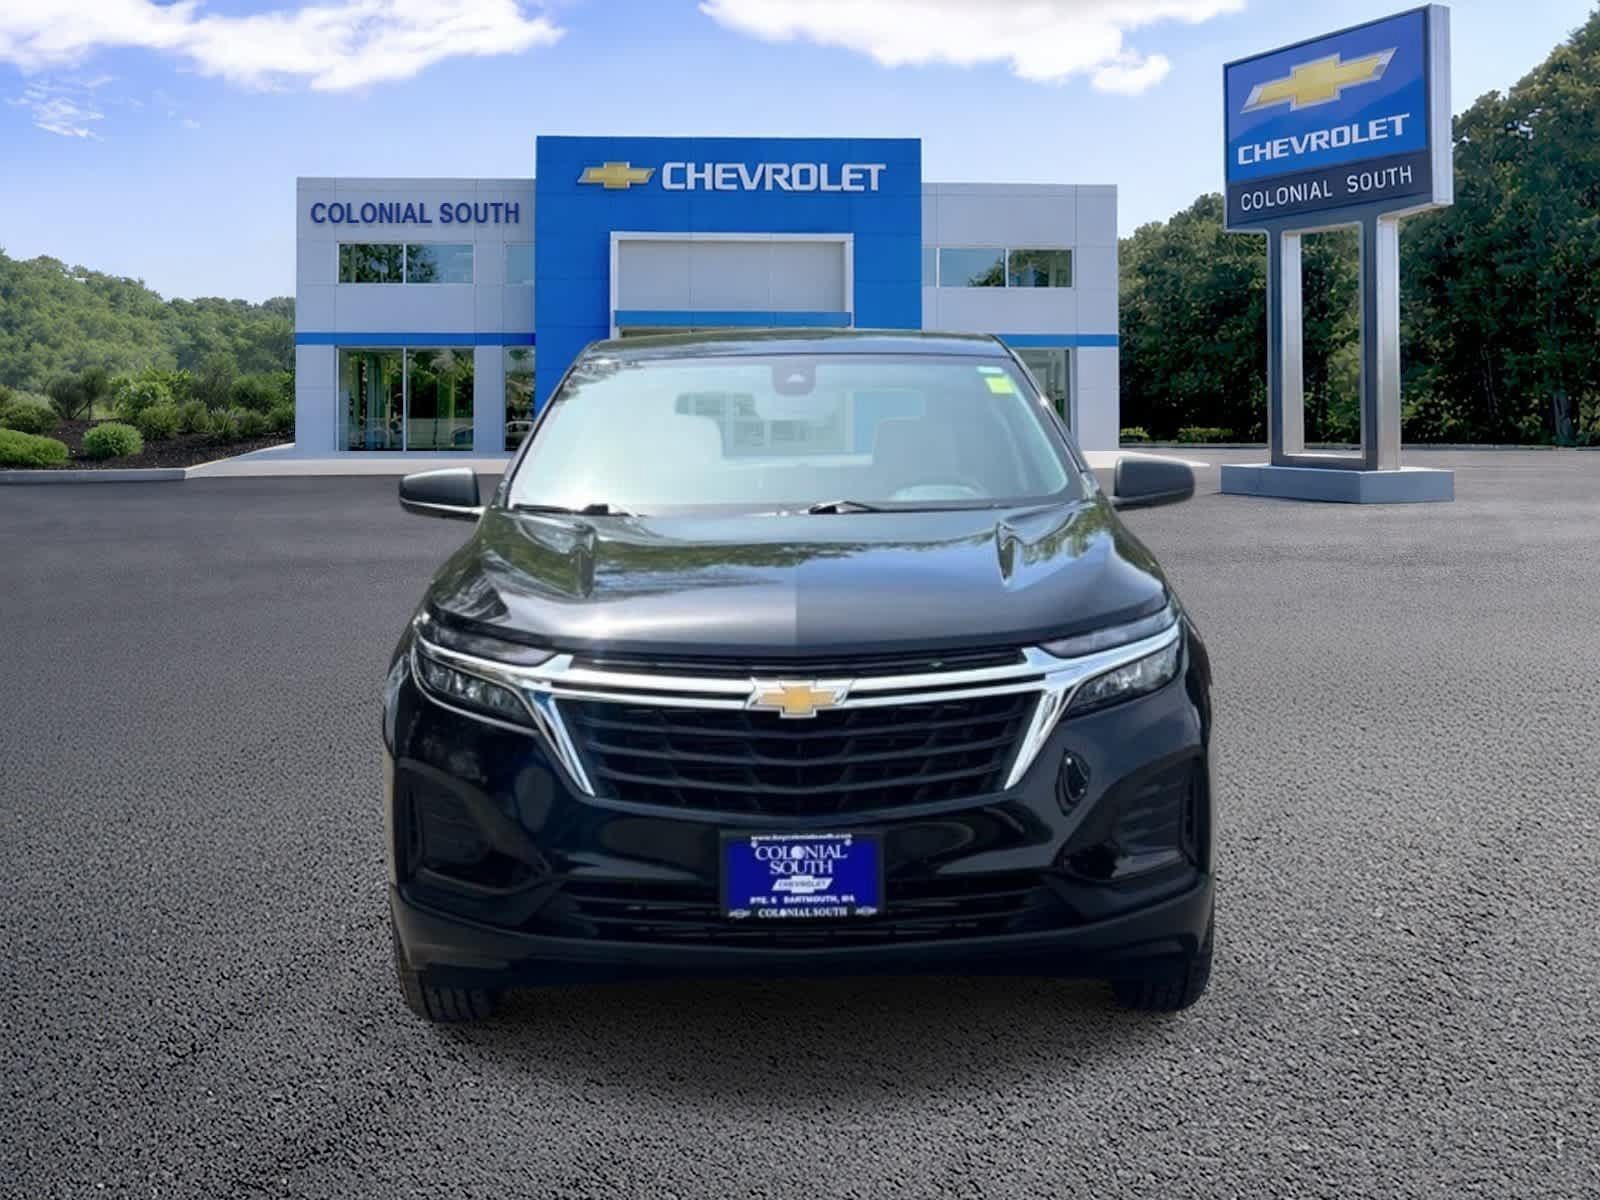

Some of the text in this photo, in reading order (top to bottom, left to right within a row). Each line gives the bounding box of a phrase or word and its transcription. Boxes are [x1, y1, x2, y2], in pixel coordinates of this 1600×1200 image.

[1237, 113, 1410, 165] CHEVROLET
[662, 162, 887, 192] CHEVROLET
[1240, 165, 1413, 211] COLONIAL SOUTH
[310, 202, 520, 224] COLONIAL SOUTH
[755, 844, 848, 860] COLONIAL
[769, 859, 833, 875] SOUTH
[778, 880, 827, 888] CHEVROLET
[758, 907, 848, 918] COLONIAL SOUTH
